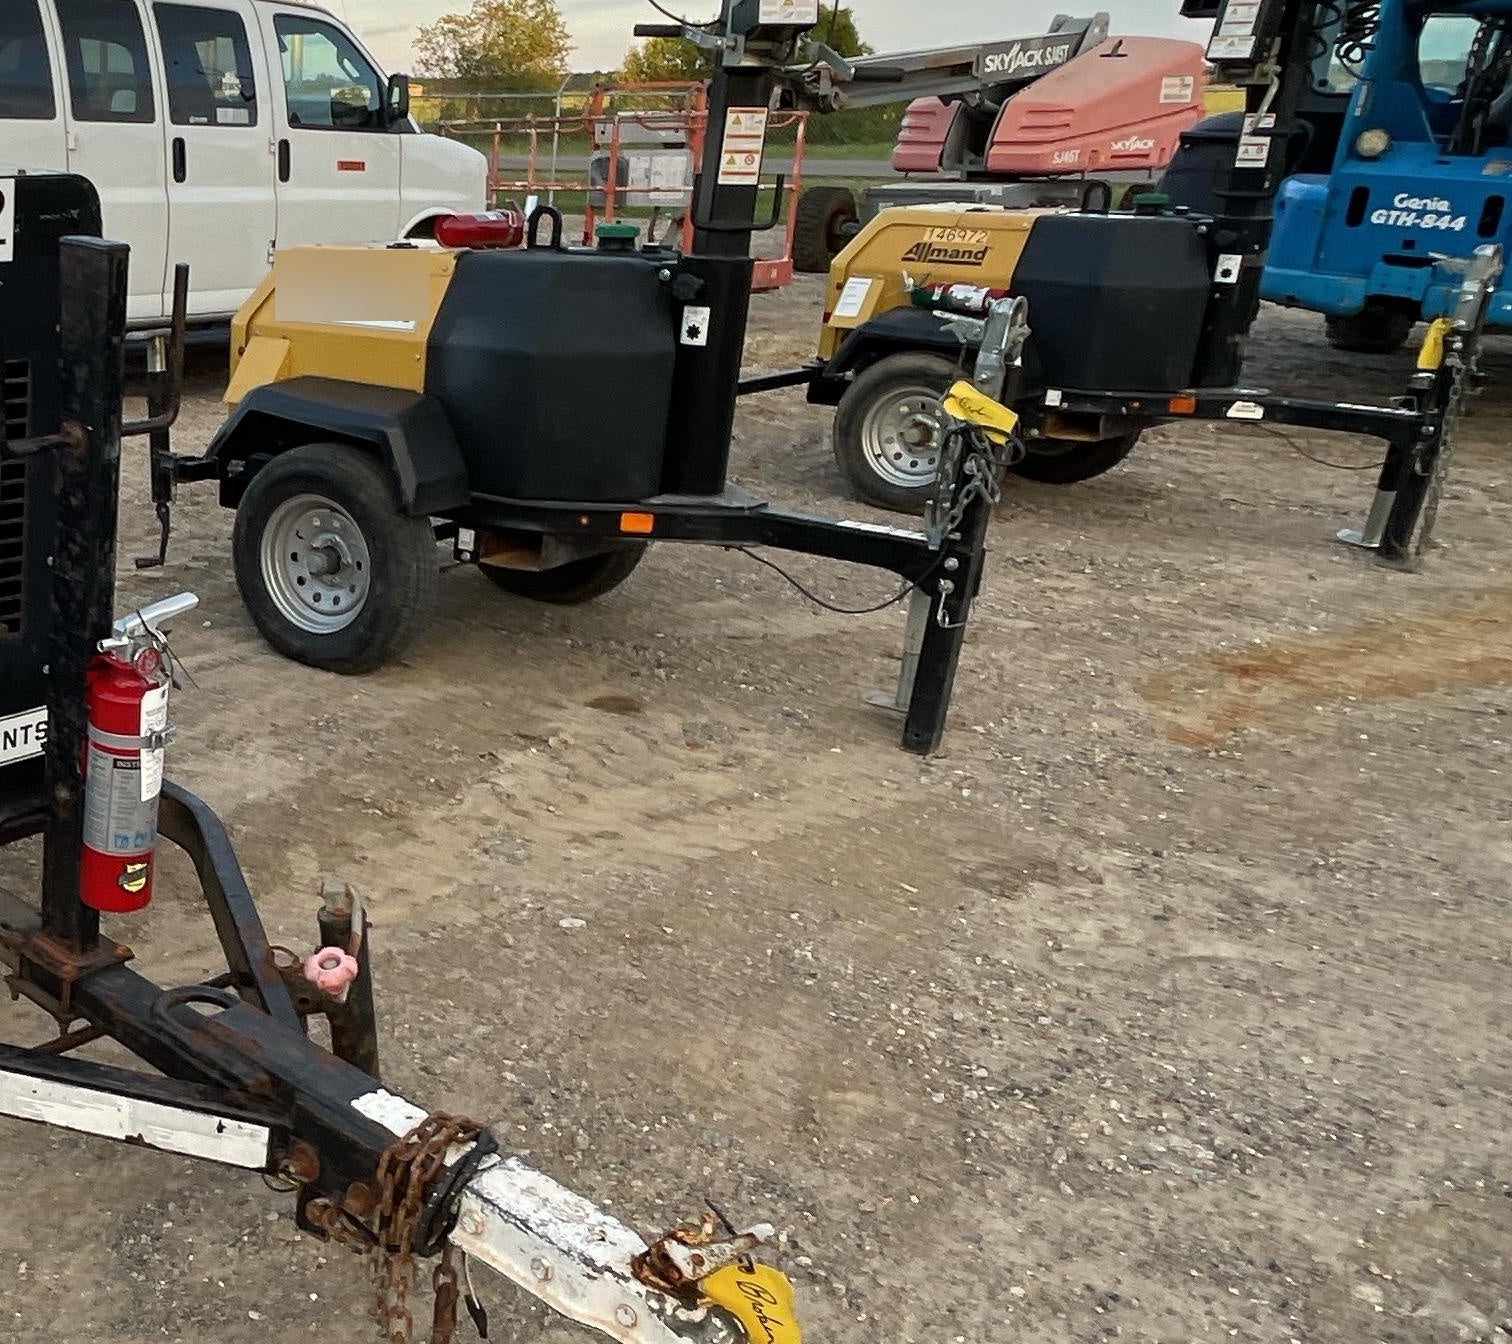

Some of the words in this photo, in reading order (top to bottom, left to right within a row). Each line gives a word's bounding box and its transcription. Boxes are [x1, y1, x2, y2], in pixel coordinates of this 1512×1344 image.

[1393, 193, 1451, 212] Genie
[1370, 209, 1466, 232] GTH-844
[903, 241, 988, 263] Allmand
